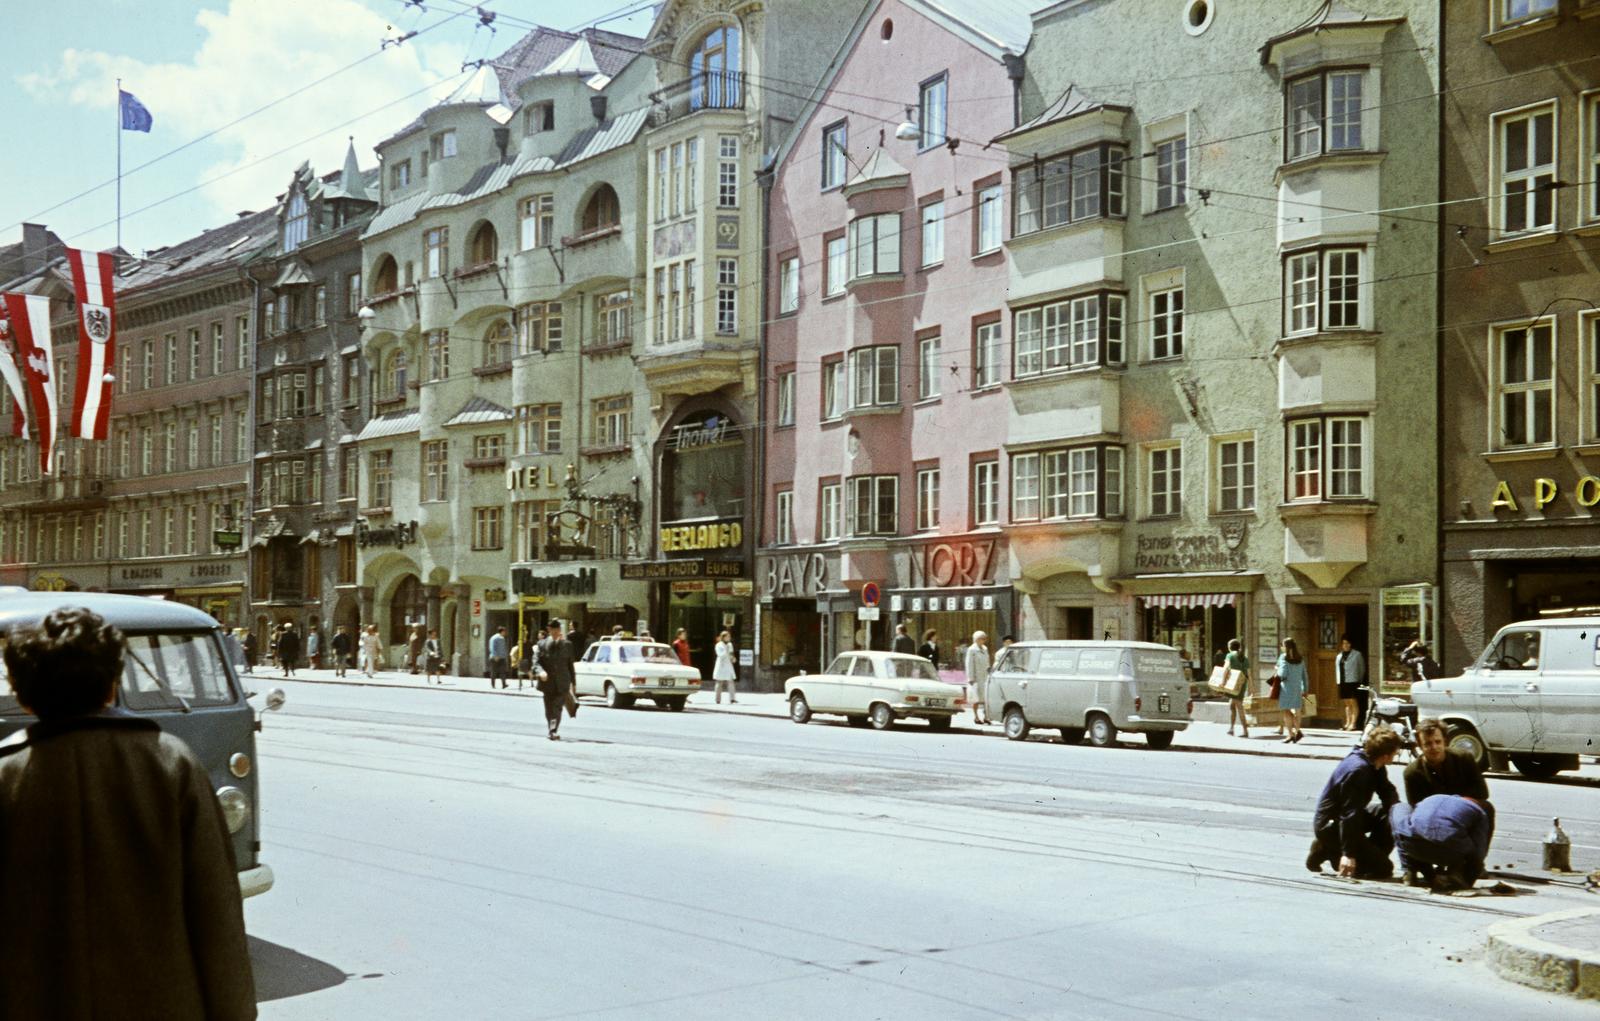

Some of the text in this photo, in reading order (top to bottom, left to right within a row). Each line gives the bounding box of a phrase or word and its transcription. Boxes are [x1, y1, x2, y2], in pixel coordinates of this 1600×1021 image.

[668, 562, 699, 577] PHOTO
[767, 553, 828, 593] BAYR
[908, 539, 997, 589] NORZ
